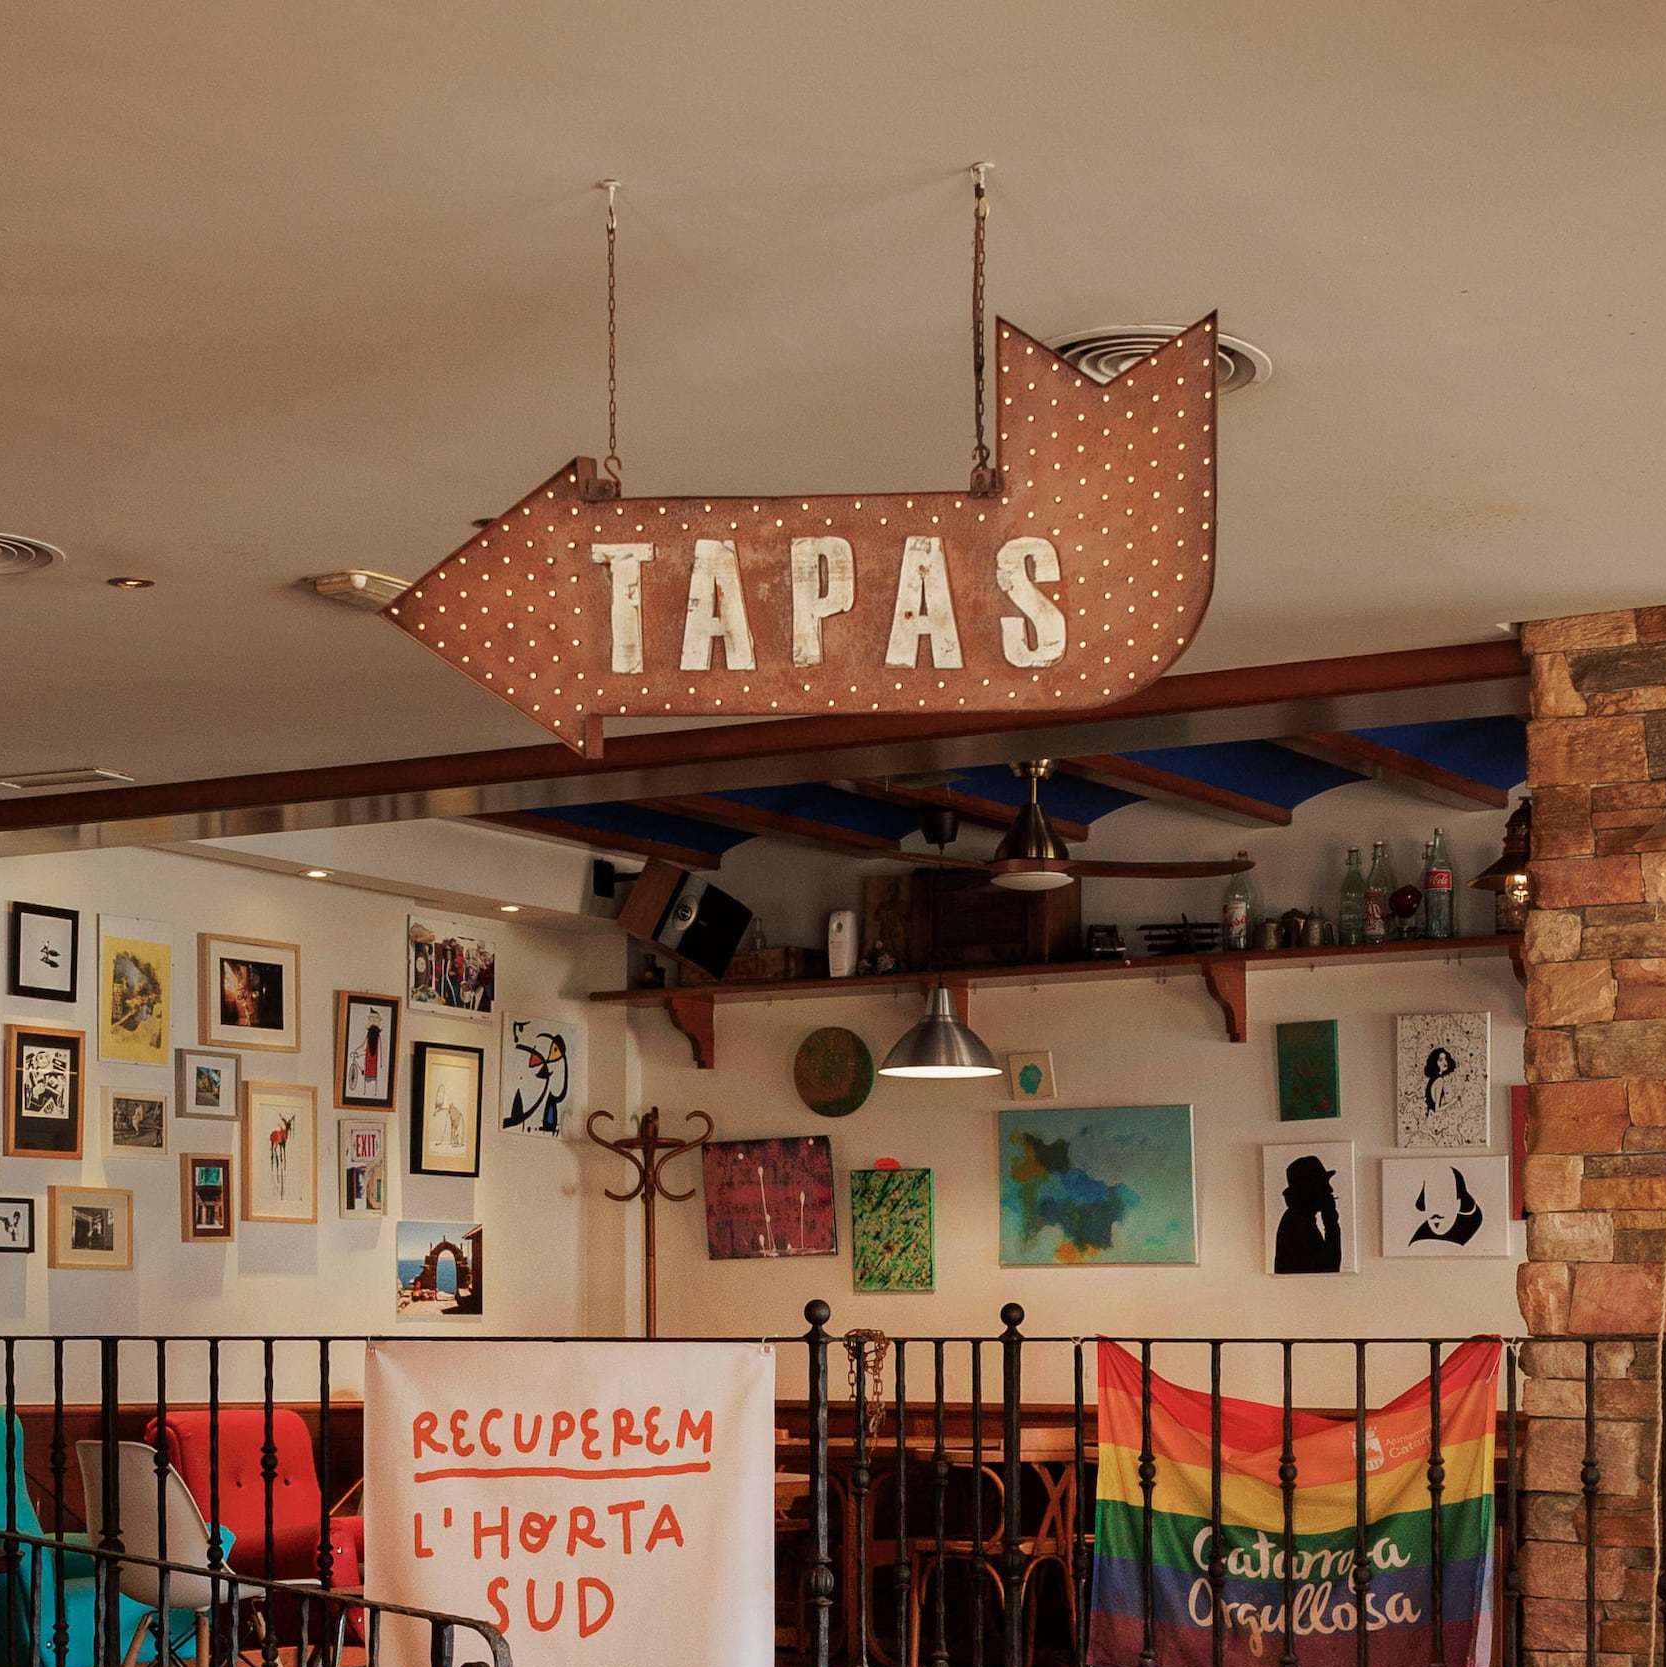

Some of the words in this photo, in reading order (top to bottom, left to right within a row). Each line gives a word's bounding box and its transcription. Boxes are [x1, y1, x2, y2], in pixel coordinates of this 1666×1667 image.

[591, 536, 1067, 673] TAPAS
[355, 1134, 376, 1157] EXIT
[413, 1406, 712, 1460] RECUPEREM
[414, 1500, 684, 1559] L'HORTA
[487, 1577, 614, 1638] SUD
[1188, 1578, 1421, 1657] Orgullosa
